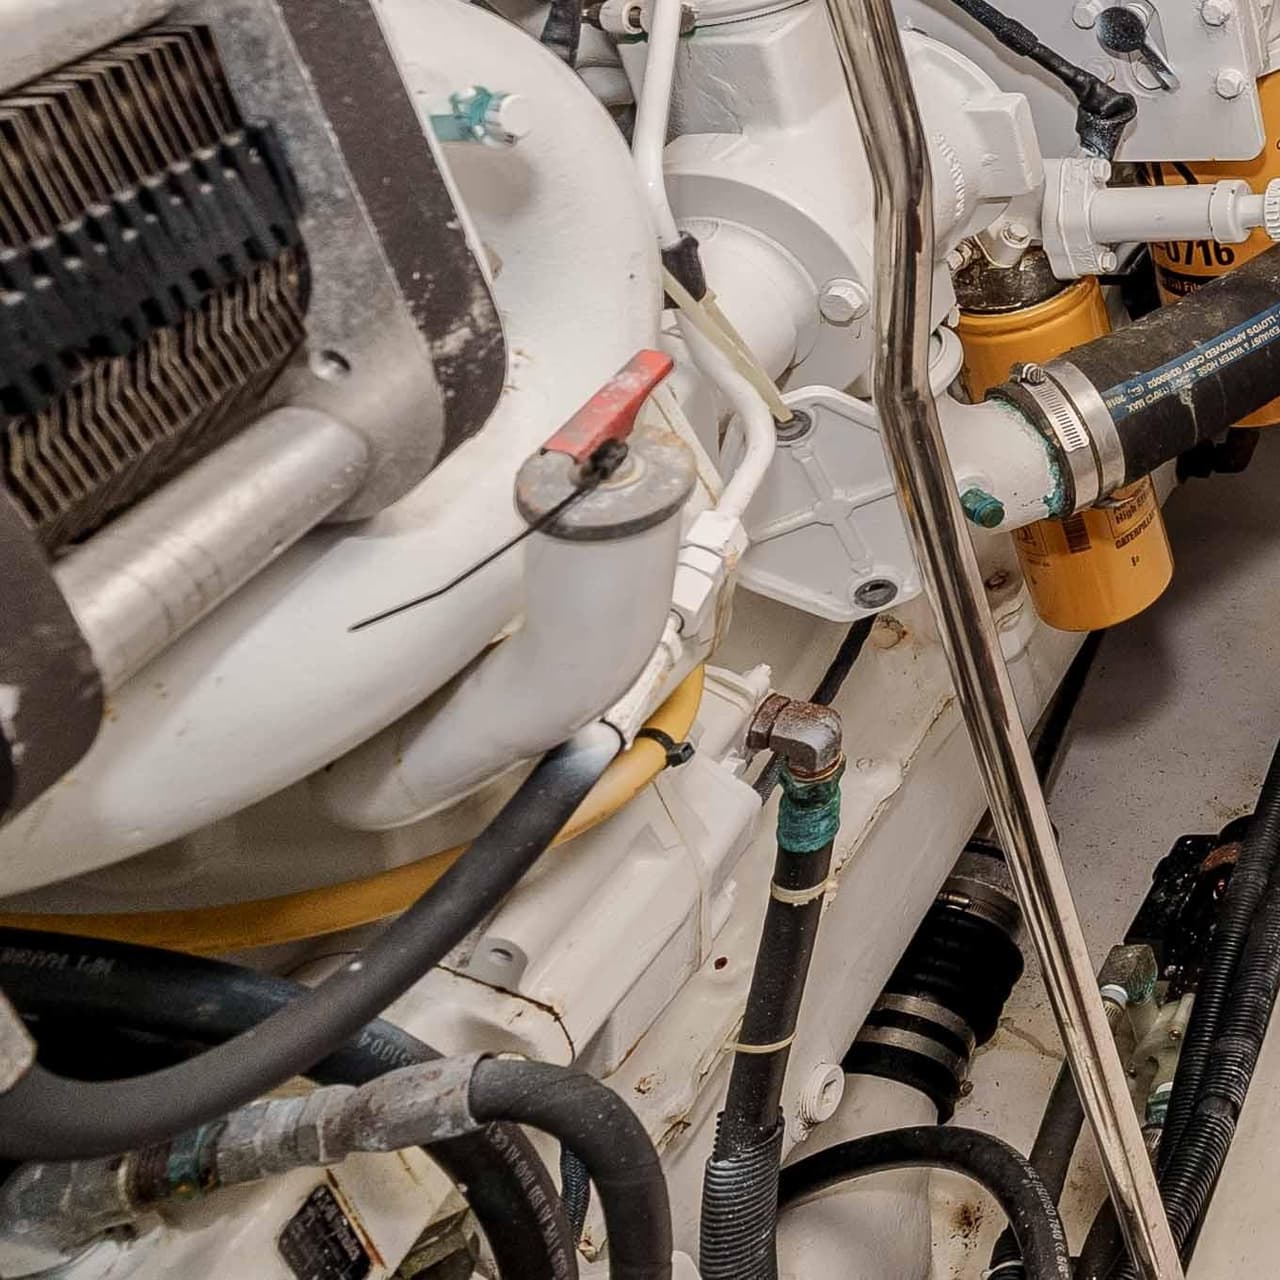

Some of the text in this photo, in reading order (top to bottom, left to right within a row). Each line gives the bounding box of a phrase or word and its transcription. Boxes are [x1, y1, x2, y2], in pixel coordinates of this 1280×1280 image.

[1250, 326, 1279, 345] EXHAUST
[1204, 332, 1246, 357] APPROVED
[1182, 355, 1203, 369] CERT
[1219, 346, 1243, 362] WATER
[1197, 360, 1217, 374] HOSE
